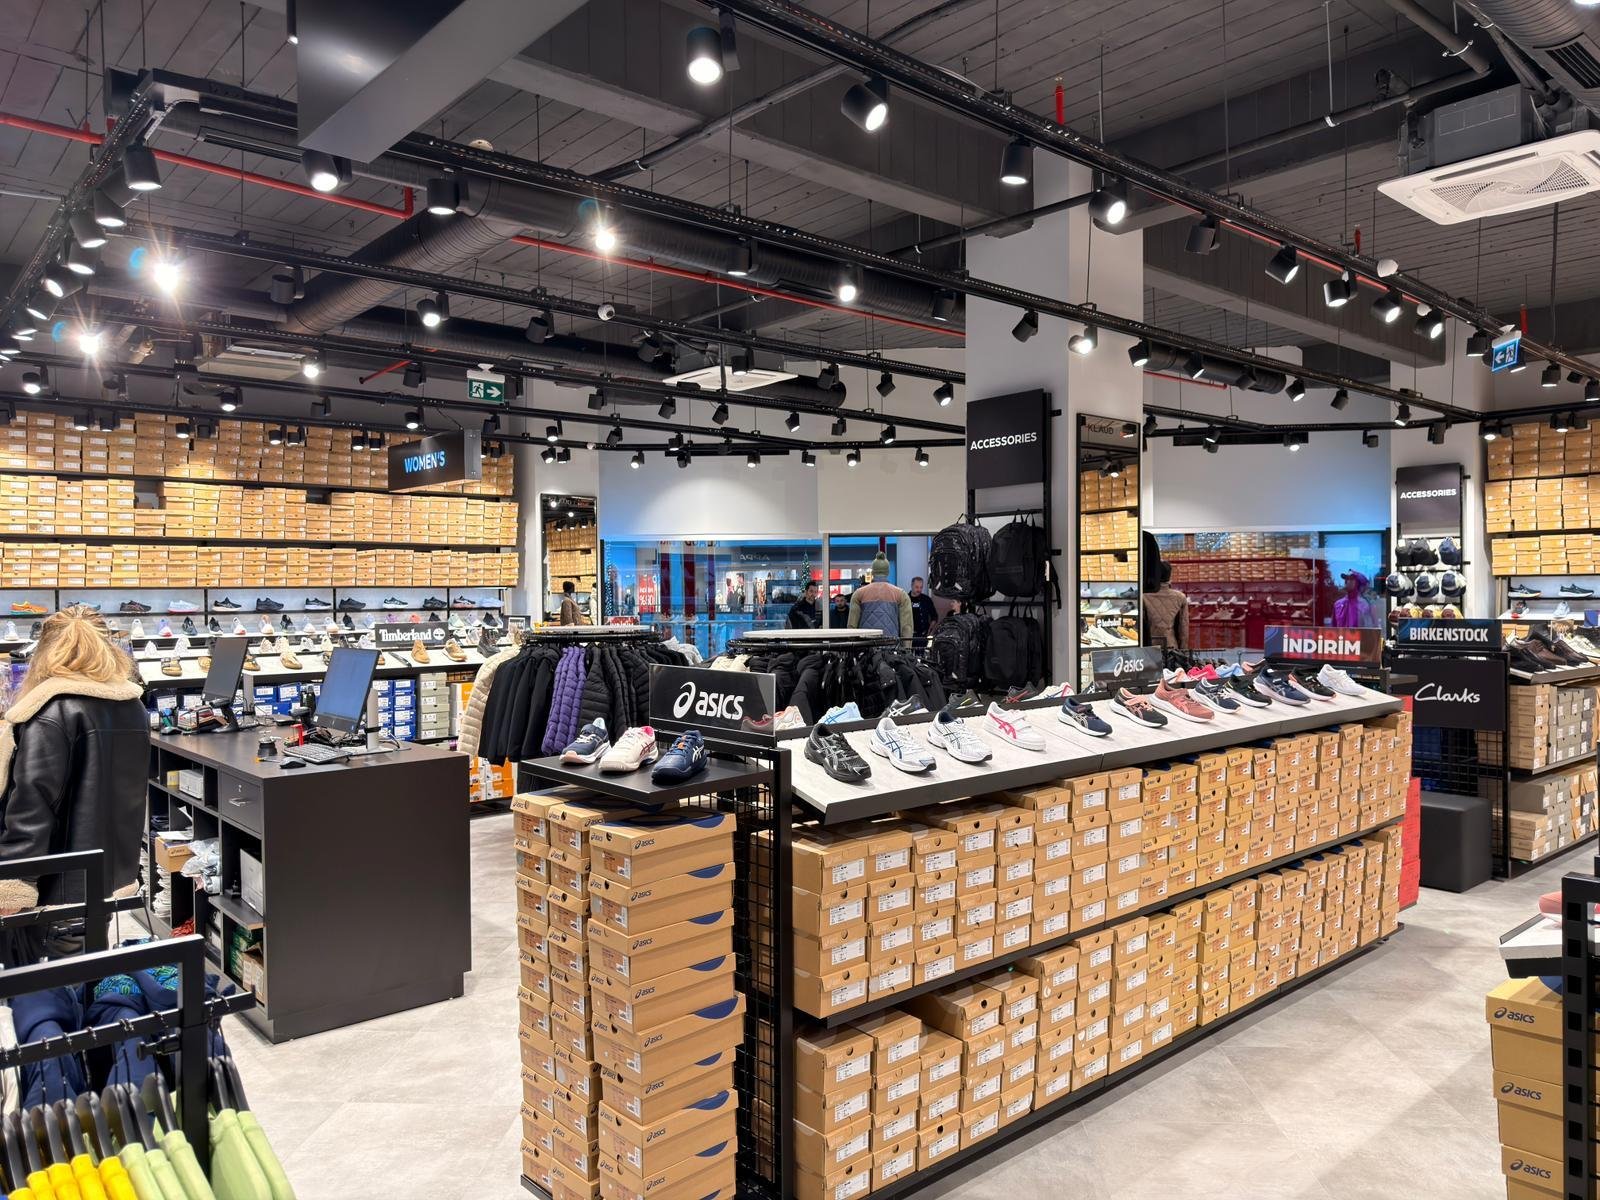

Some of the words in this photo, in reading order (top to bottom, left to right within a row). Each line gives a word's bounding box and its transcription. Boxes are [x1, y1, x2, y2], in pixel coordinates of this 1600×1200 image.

[970, 432, 1037, 450] ACCESSORIES
[404, 451, 446, 473] WOMEN'S
[1400, 489, 1457, 499] ACCESSORIES
[379, 628, 432, 642] Timberland
[1410, 628, 1488, 642] BIRKENSTOCK
[1283, 634, 1361, 655] İNDİRİM
[1414, 683, 1481, 703] Clarks
